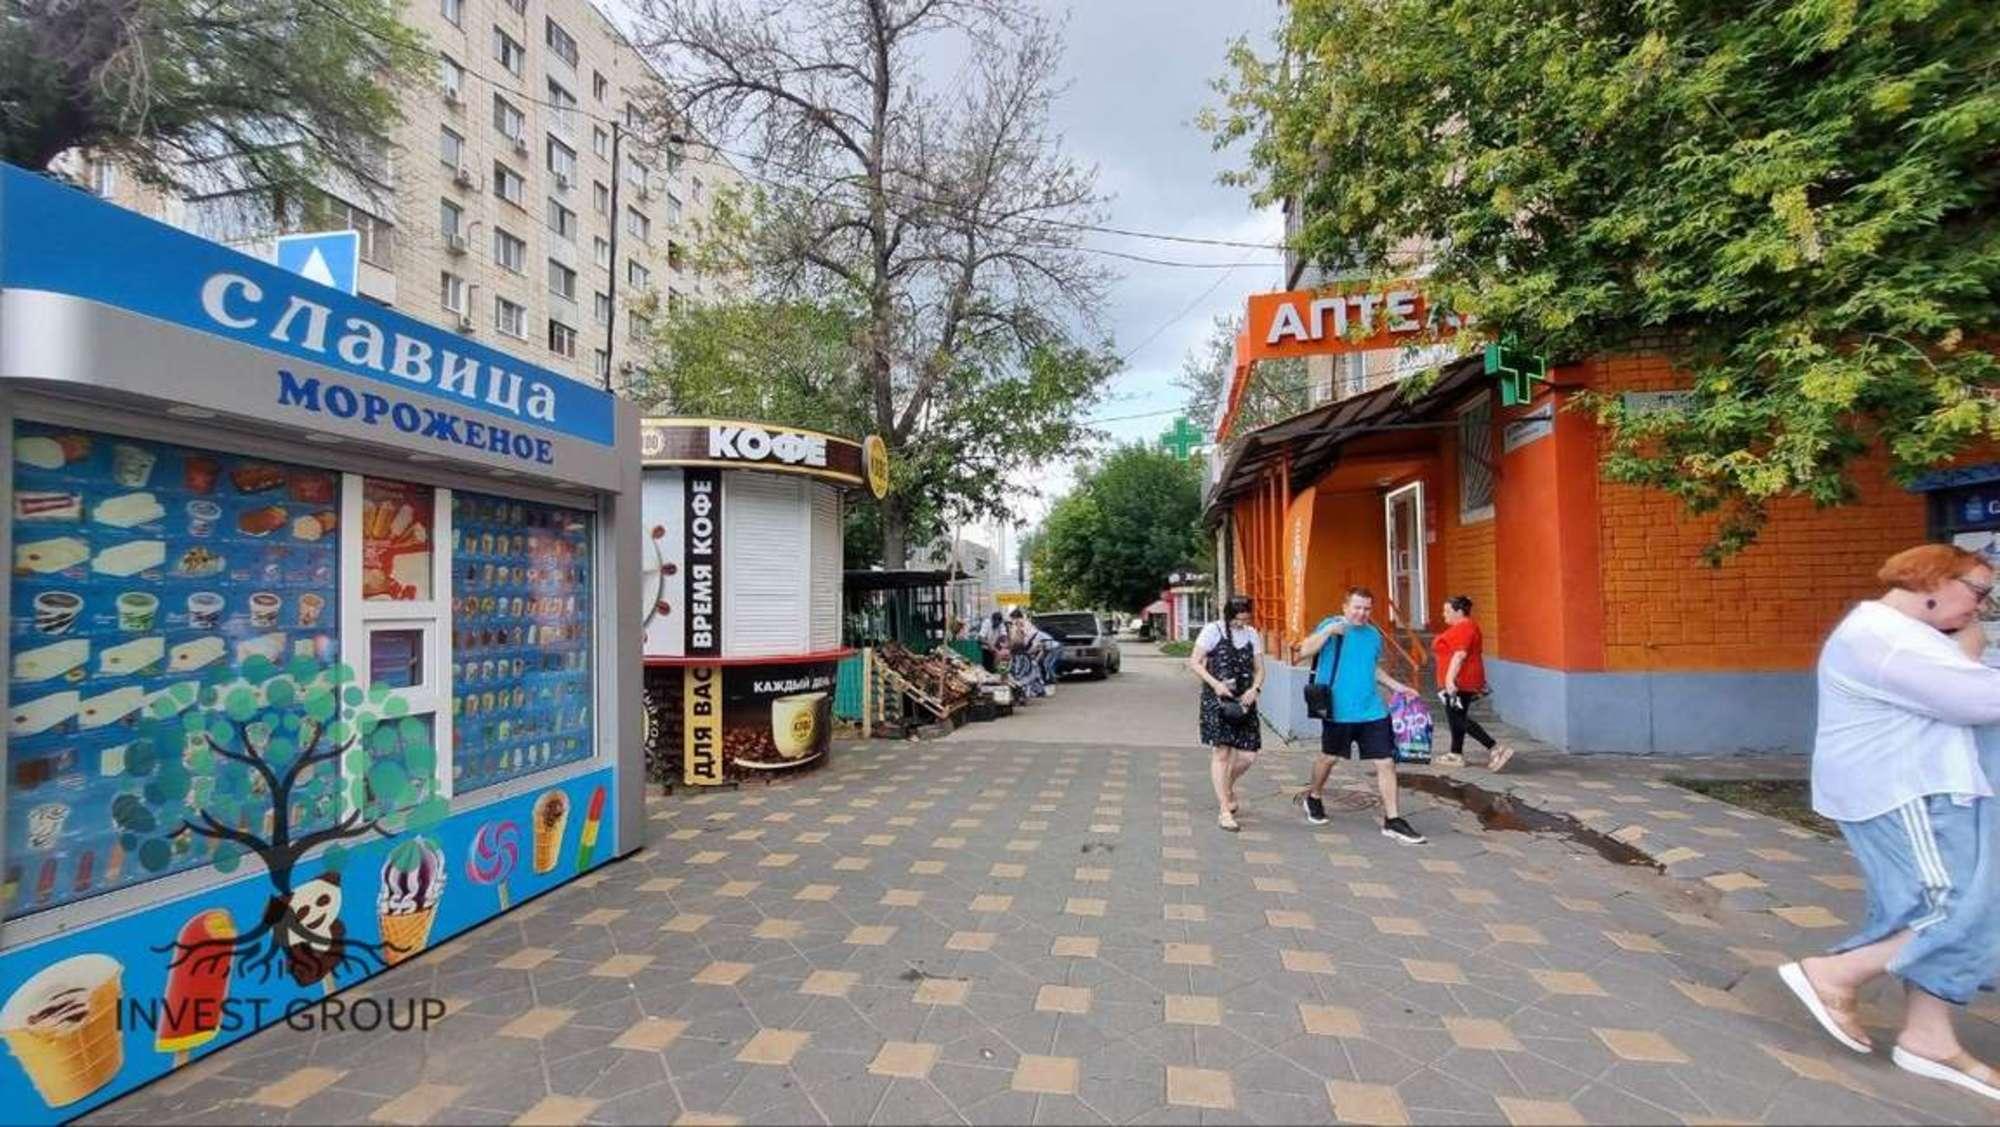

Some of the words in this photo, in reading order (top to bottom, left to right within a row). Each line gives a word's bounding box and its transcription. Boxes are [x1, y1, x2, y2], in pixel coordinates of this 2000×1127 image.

[1266, 289, 1485, 344] АПТЕ
[278, 370, 554, 464] МОРОЖЕНОЕ
[709, 426, 827, 466] КОФЕ
[692, 481, 713, 554] КОФЕ
[692, 565, 713, 648] ВРЕМЯ
[753, 675, 810, 693] КАЖДЫЙ
[694, 726, 716, 778] ДЛЯ
